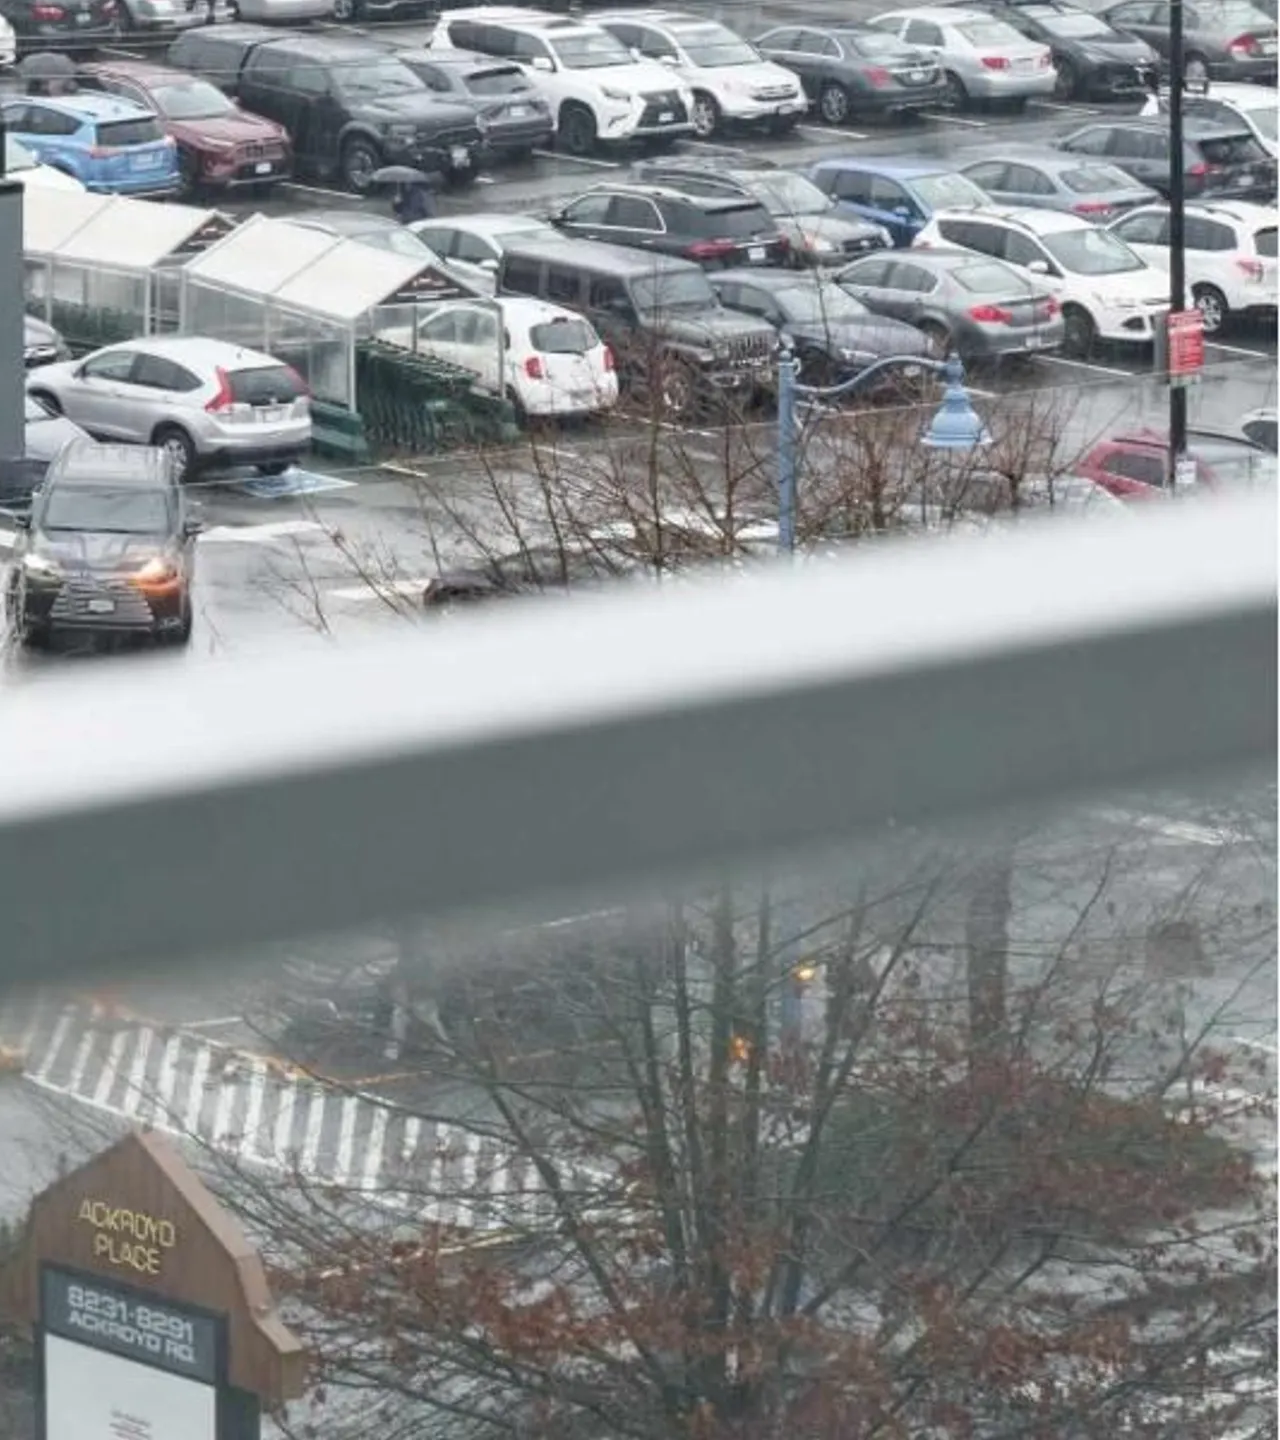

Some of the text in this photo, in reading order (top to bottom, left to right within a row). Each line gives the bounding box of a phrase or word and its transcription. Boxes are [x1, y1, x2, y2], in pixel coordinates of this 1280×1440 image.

[78, 1199, 177, 1248] ACKROYD
[94, 1233, 162, 1275] PLACE
[68, 1309, 162, 1354] ACKROYD
